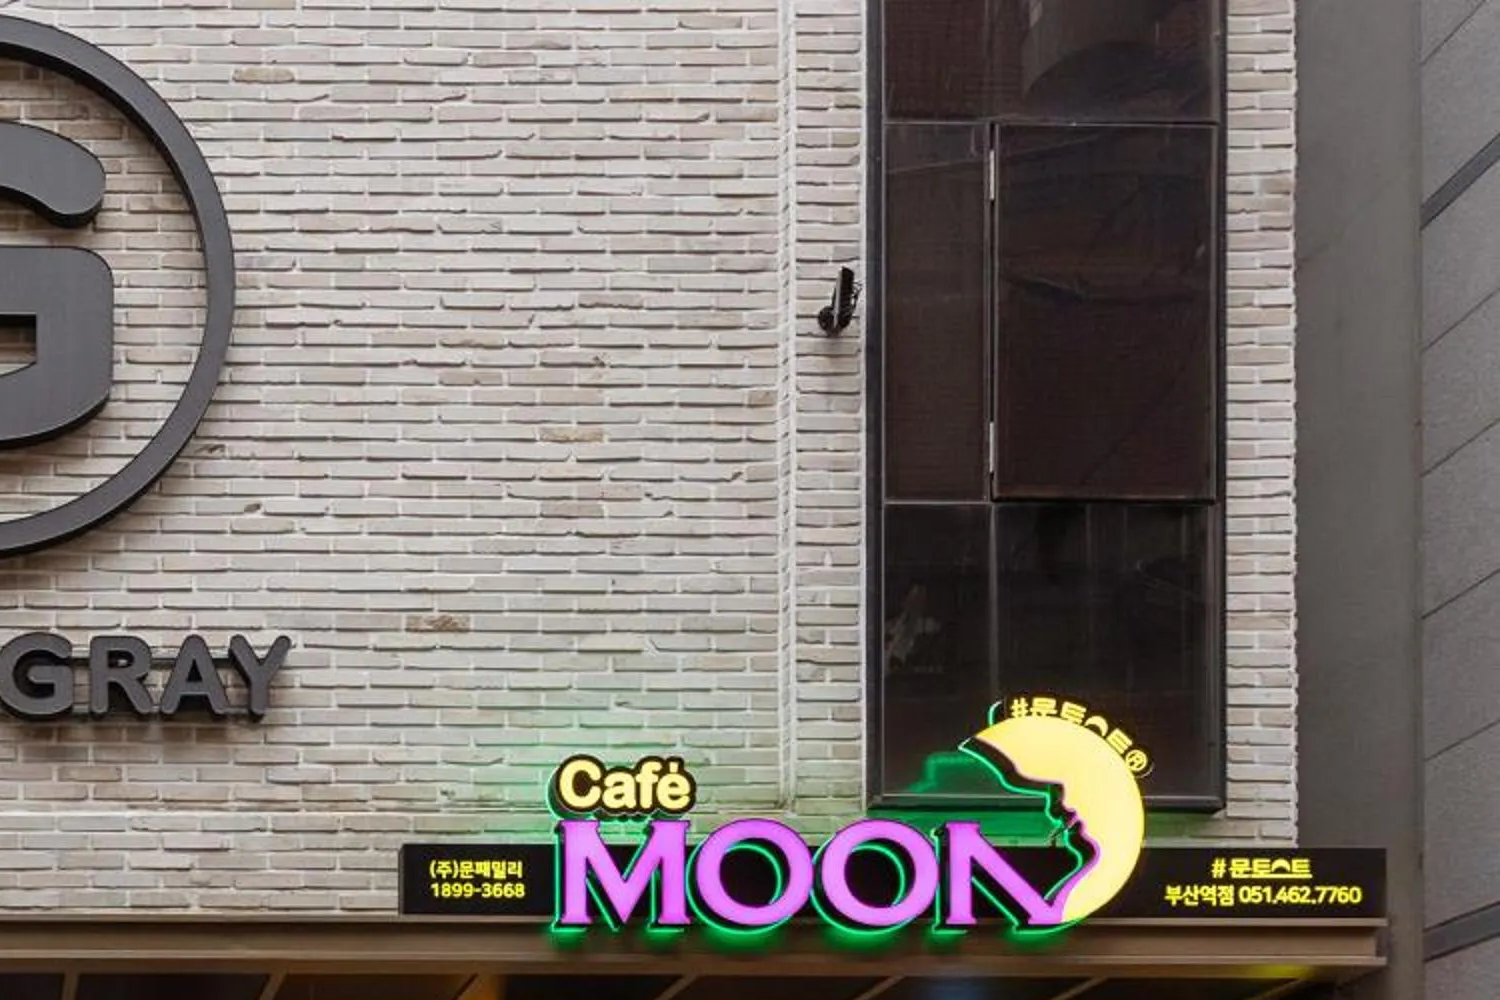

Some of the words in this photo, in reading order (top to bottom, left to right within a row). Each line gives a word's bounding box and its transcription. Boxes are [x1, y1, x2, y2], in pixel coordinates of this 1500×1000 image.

[558, 756, 693, 811] Café
[430, 882, 526, 898] 1899-3668
[559, 818, 1098, 926] MOON
[1165, 885, 1235, 907] 부산역점
[1238, 885, 1363, 904] 051.462.7760
